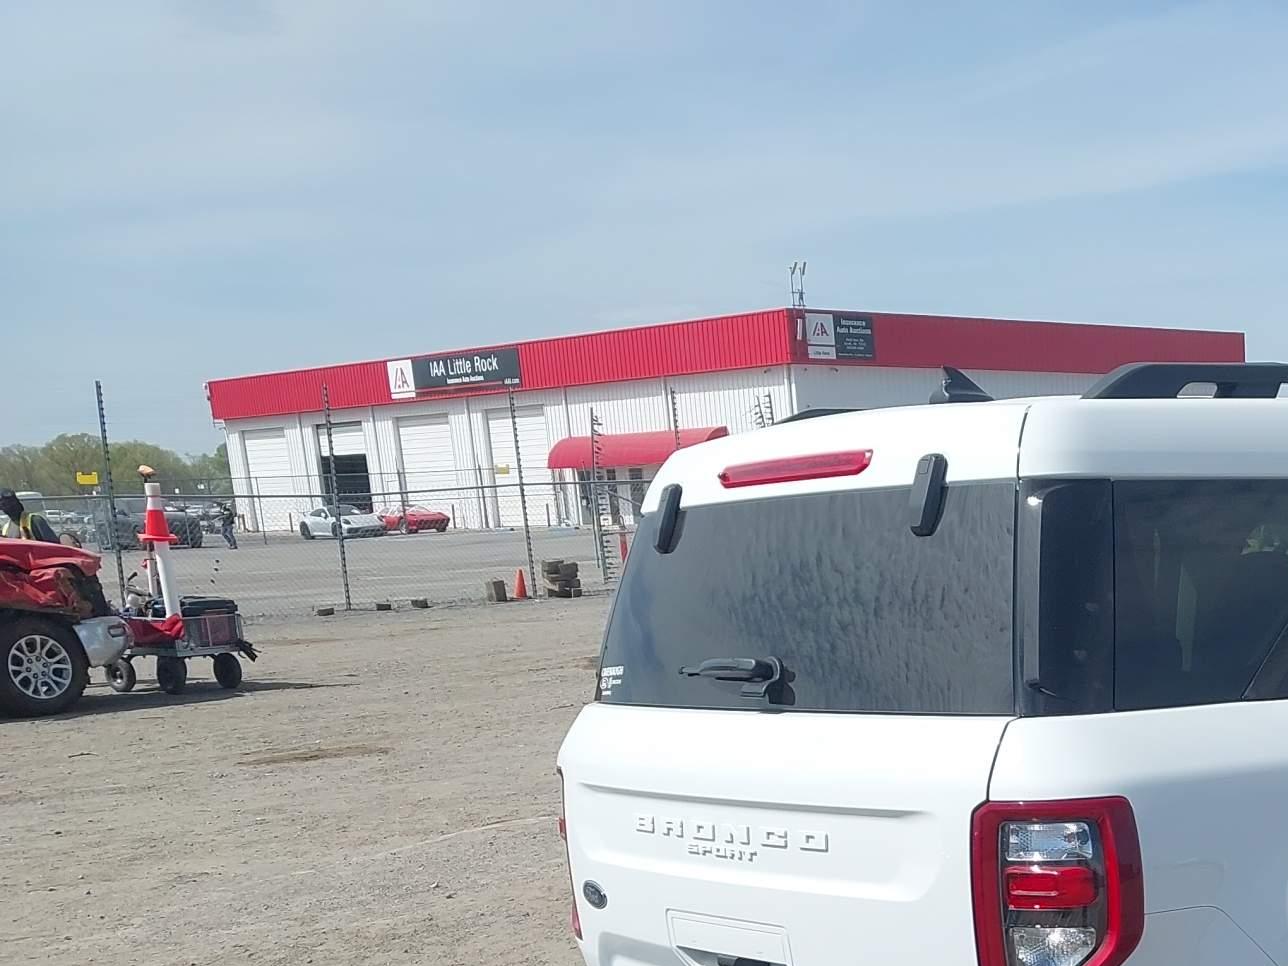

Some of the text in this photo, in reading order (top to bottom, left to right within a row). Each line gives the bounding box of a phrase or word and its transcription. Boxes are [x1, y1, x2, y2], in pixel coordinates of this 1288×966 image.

[429, 354, 499, 377] IAA Little Rock
[635, 814, 829, 853] BRONCO
[687, 843, 758, 863] SPORT
